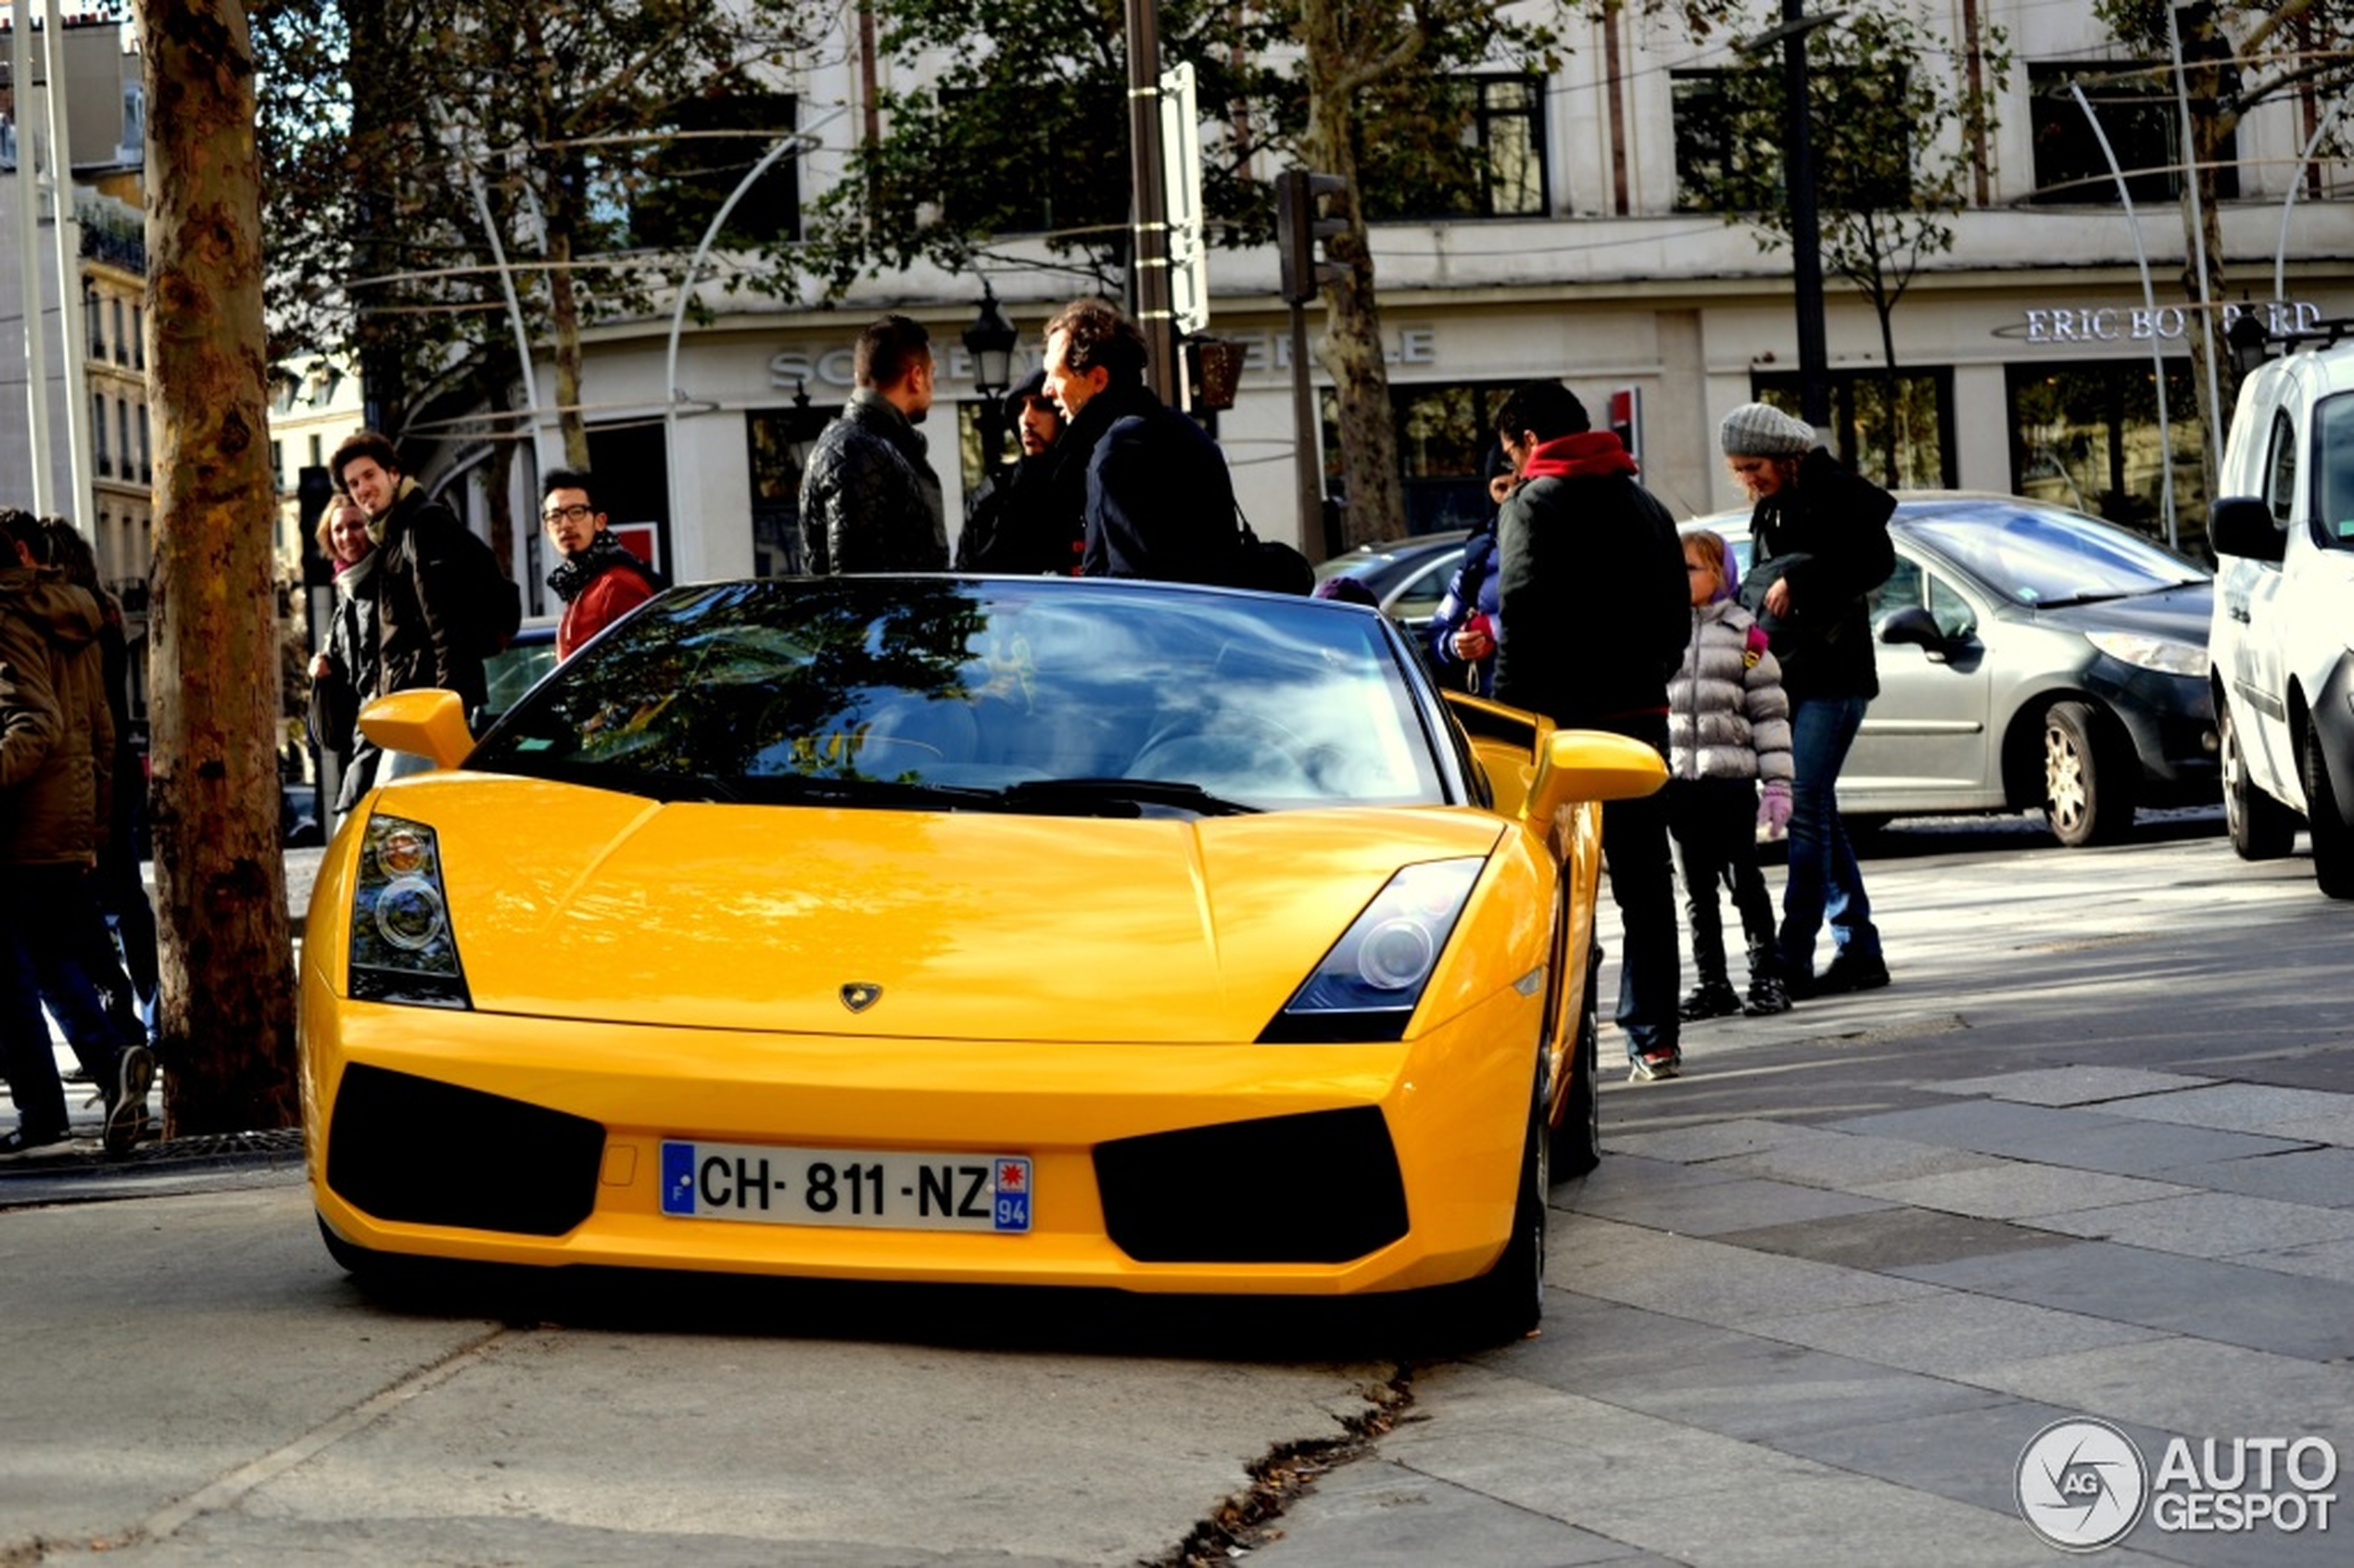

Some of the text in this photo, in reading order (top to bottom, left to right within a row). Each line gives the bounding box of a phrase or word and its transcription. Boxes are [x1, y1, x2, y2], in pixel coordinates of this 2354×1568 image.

[2026, 301, 2321, 341] ERIC BOPRD
[997, 1198, 1026, 1224] 94
